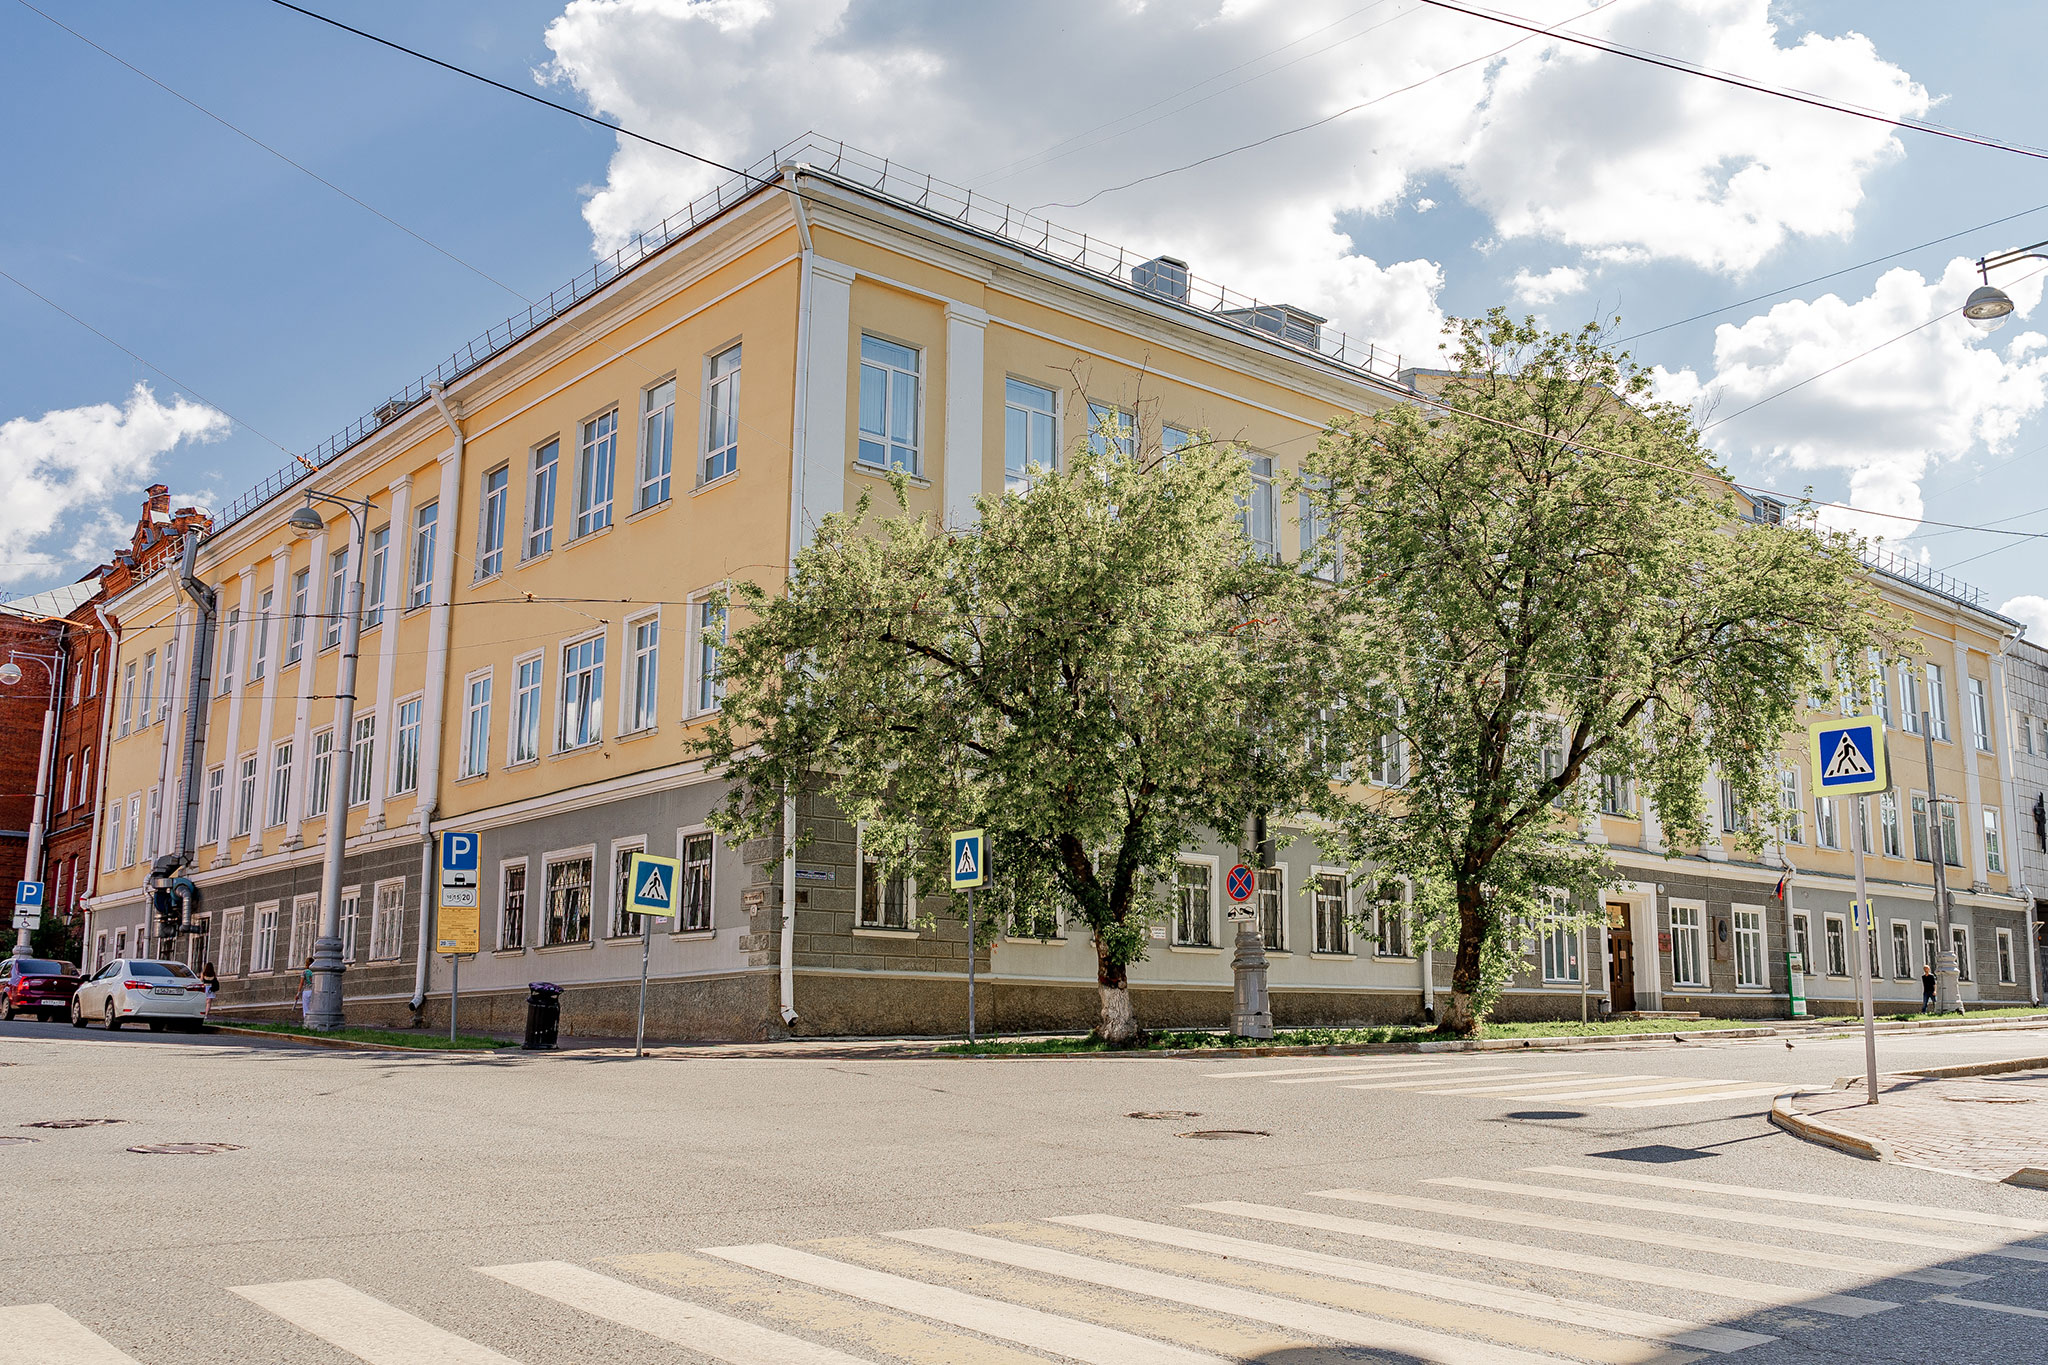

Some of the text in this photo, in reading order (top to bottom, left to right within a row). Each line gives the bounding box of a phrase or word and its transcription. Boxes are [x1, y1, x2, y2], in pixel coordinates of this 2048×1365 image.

[452, 836, 471, 865] P
[22, 884, 37, 902] P
[462, 893, 471, 901] 20
